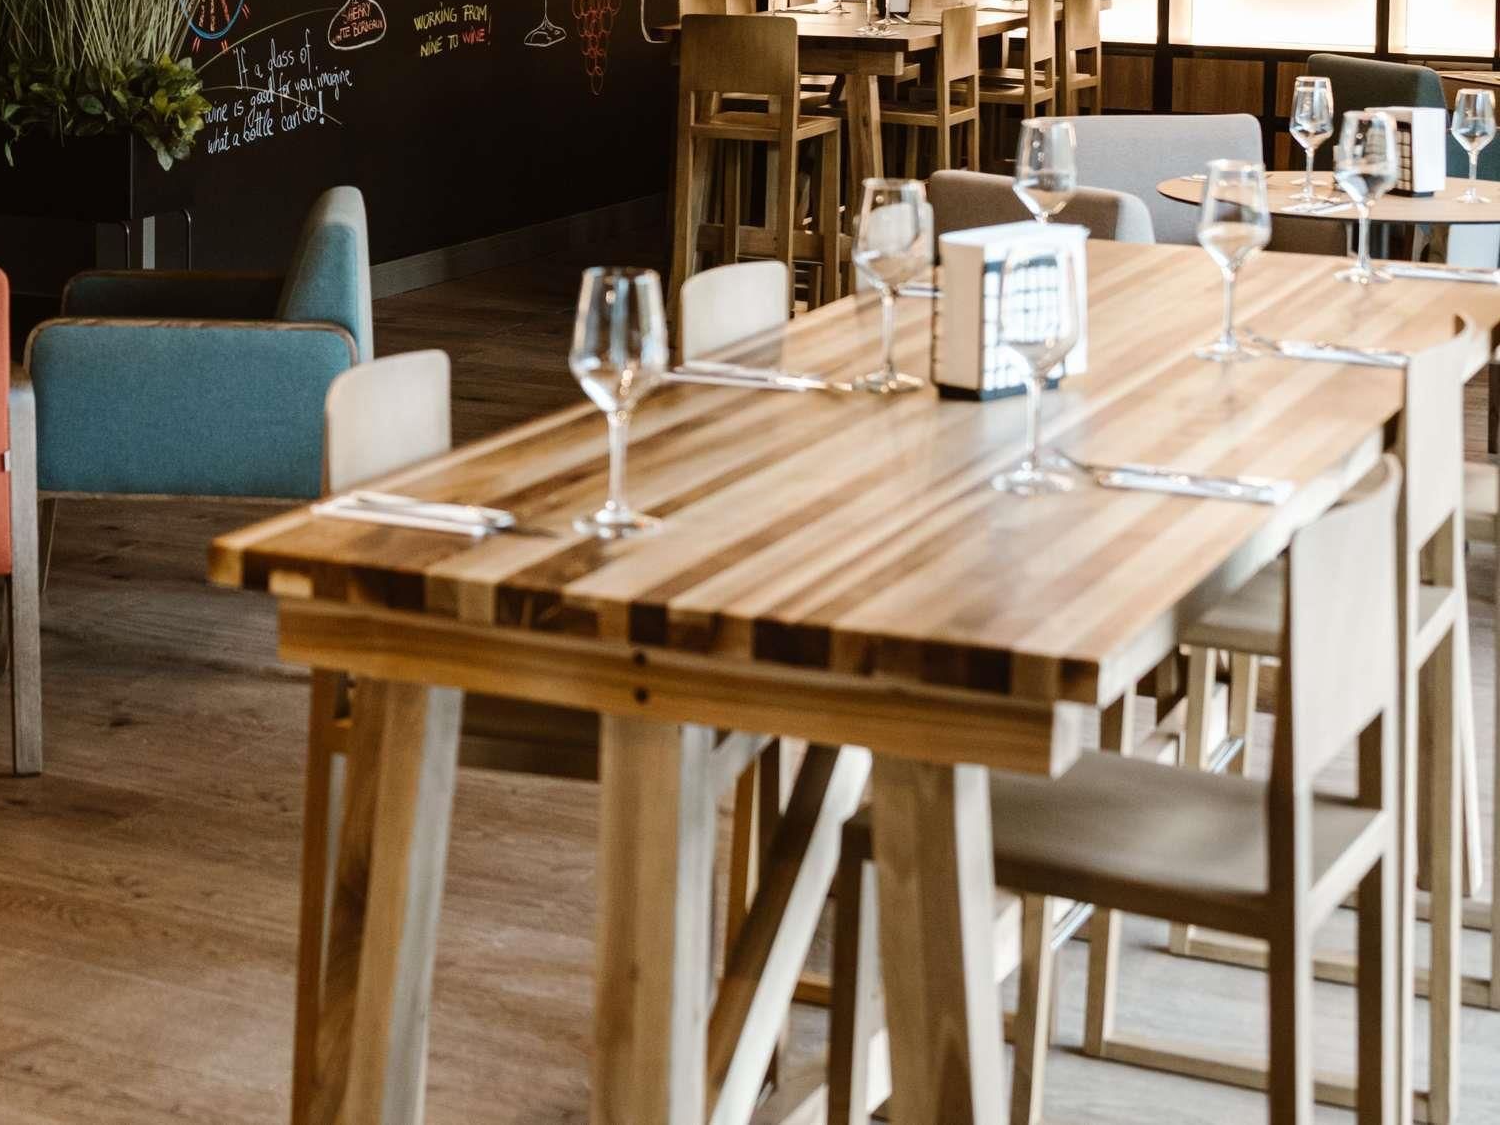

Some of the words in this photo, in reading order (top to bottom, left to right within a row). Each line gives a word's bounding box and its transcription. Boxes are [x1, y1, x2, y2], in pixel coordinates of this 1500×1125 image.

[413, 2, 458, 31] WORKING
[461, 4, 488, 22] FROM
[233, 41, 250, 91] If
[254, 64, 263, 78] a
[267, 37, 295, 72] glass
[300, 28, 311, 74] of
[420, 35, 444, 58] NINE
[448, 35, 460, 52] TO
[204, 101, 229, 125] wine
[233, 99, 245, 117] is
[245, 75, 276, 127] good
[278, 72, 292, 114] for
[315, 66, 353, 101] imagine
[207, 126, 231, 155] what
[232, 131, 240, 147] a
[243, 108, 274, 143] bottle
[281, 109, 300, 132] can
